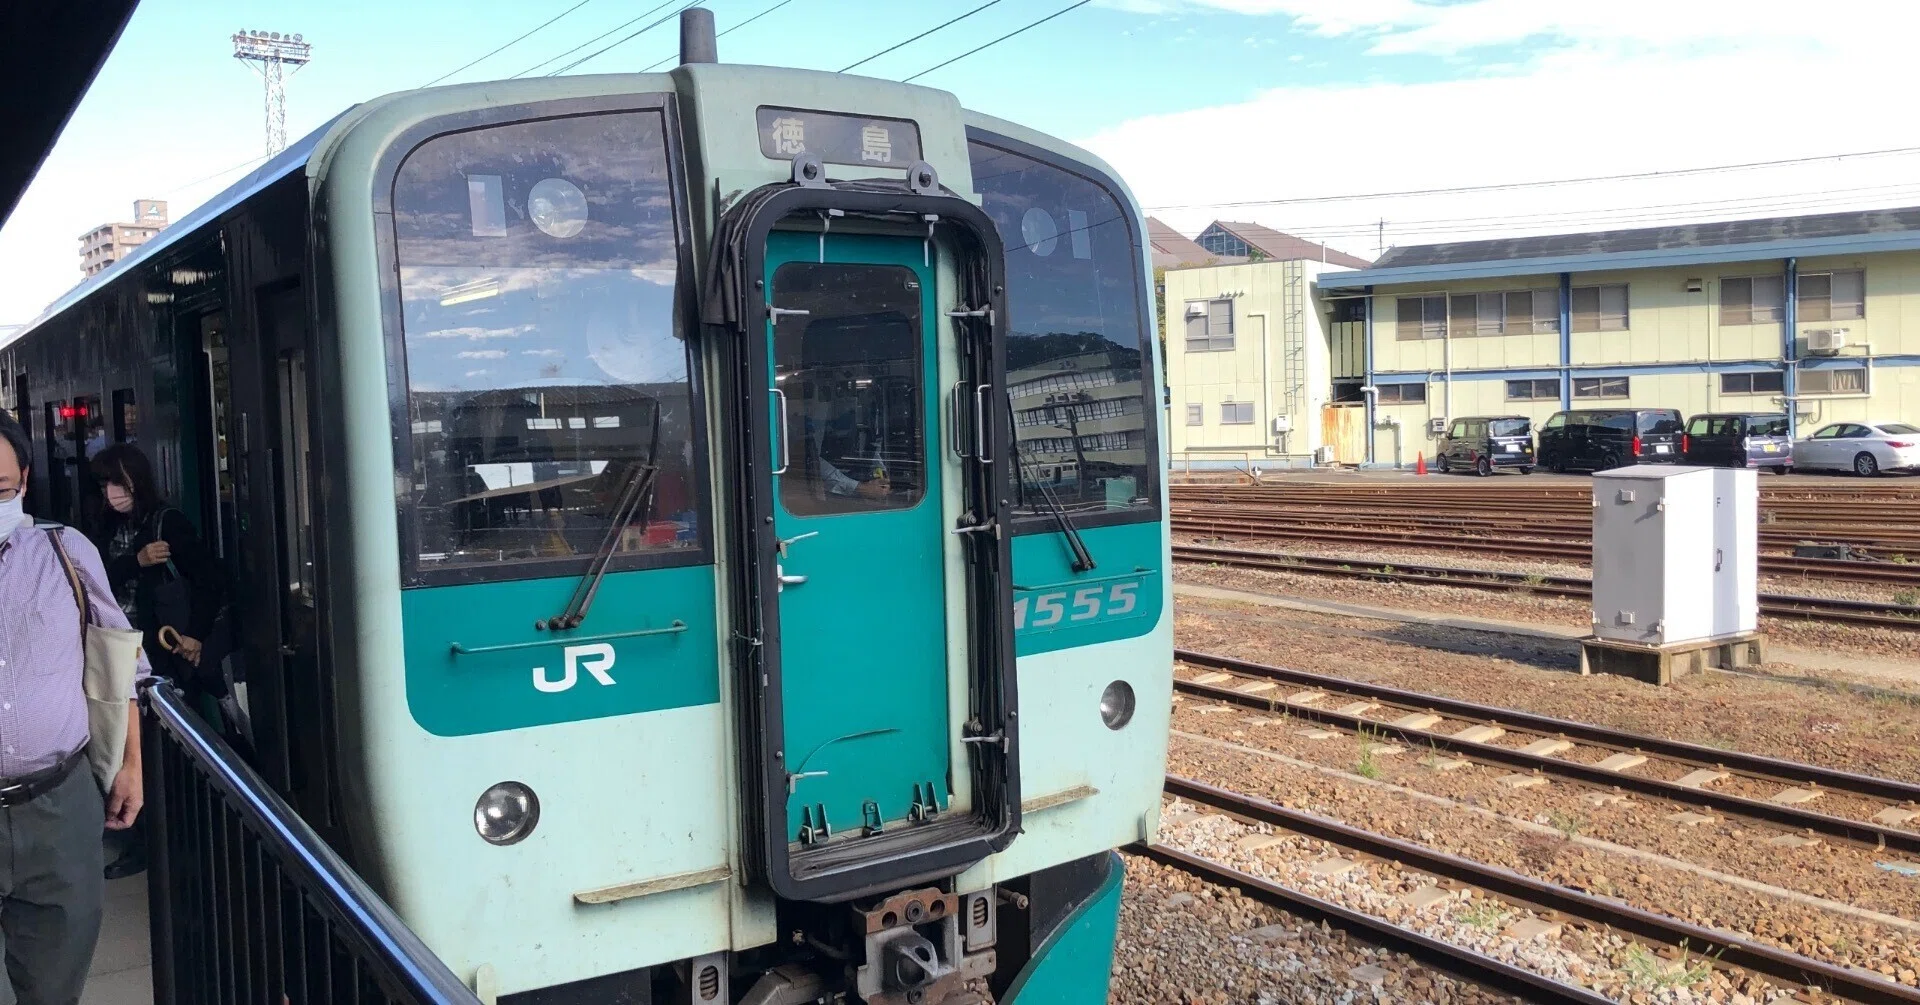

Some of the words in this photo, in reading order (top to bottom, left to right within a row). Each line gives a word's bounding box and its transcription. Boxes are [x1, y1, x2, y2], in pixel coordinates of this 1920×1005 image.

[772, 117, 892, 163] 徳島
[1014, 582, 1139, 630] 1555
[533, 643, 617, 692] JR
